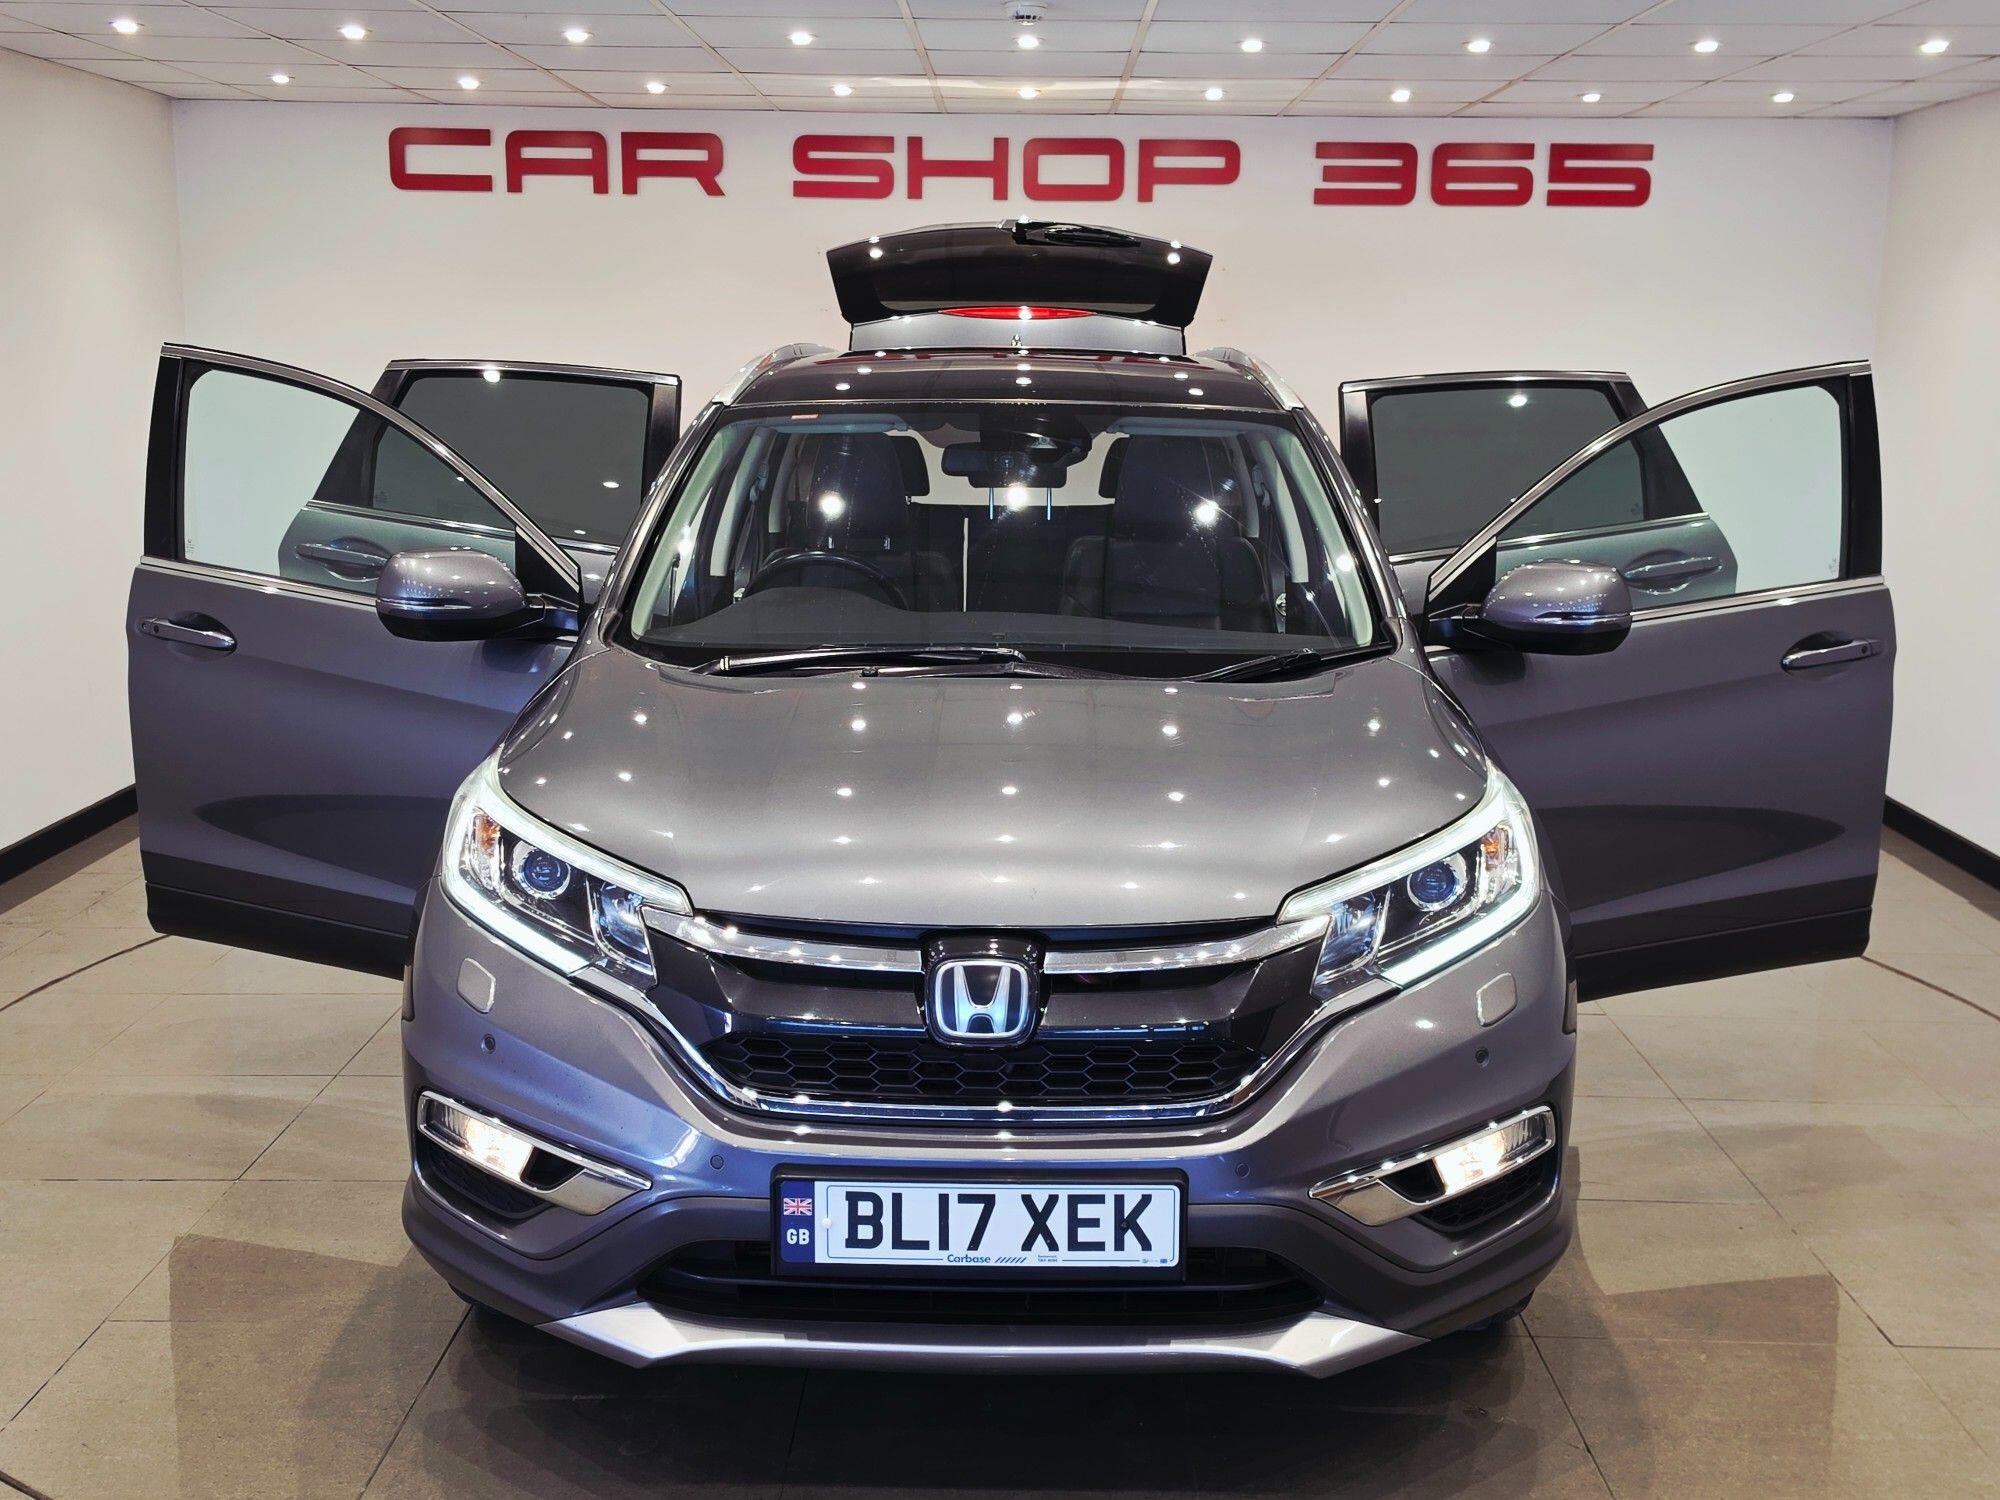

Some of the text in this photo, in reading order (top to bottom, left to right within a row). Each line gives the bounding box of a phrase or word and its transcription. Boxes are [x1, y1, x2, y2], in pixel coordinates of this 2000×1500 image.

[389, 127, 1654, 208] CAR SHOP 365
[786, 1228, 810, 1246] GB
[844, 1190, 1153, 1252] BL17 XEK
[946, 1253, 992, 1265] Carbase
